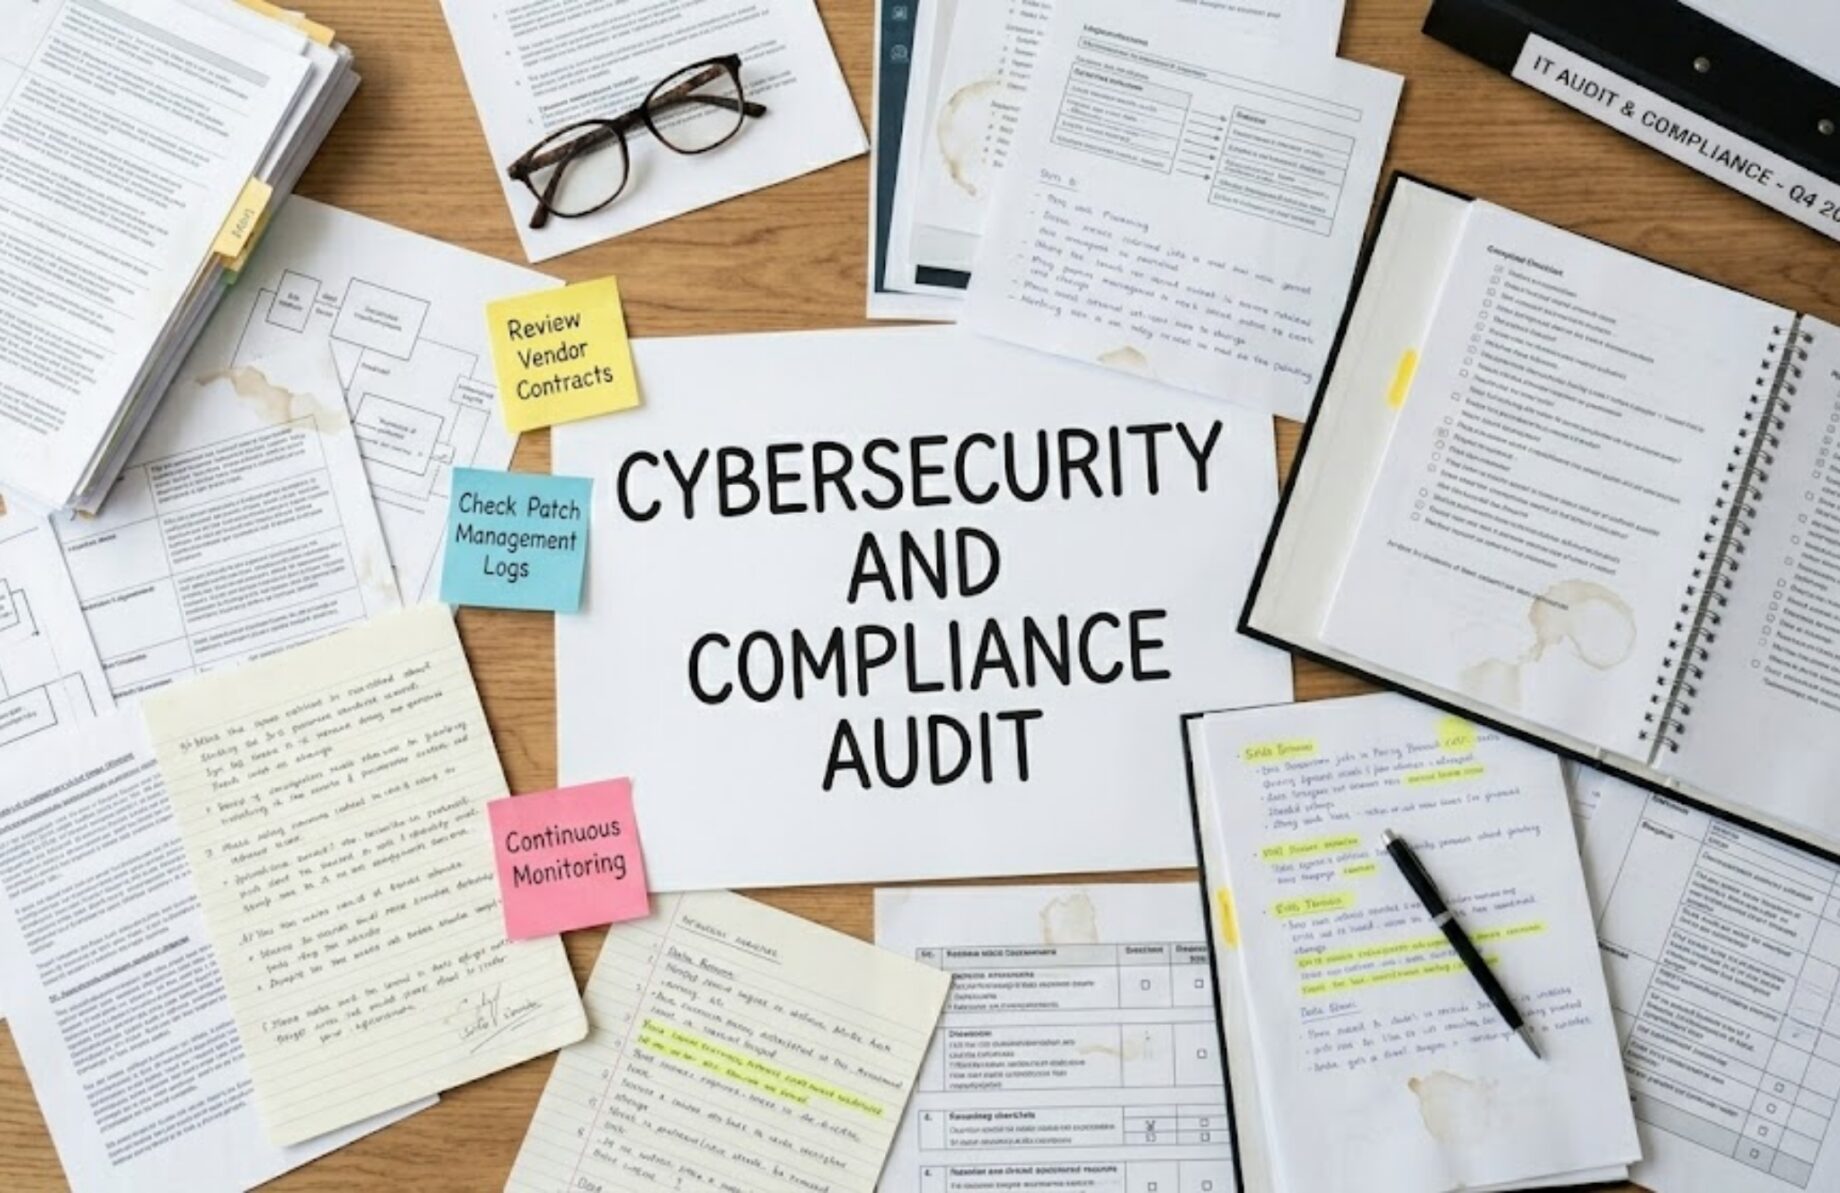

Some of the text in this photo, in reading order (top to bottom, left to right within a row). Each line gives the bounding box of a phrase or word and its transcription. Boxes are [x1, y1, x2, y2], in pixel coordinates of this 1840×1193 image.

[1533, 55, 1556, 75] IT
[1556, 68, 1619, 107] AUDIT
[1620, 100, 1635, 118] &
[1641, 110, 1774, 186] COMPLIANCE
[1789, 184, 1818, 208] Q4
[507, 313, 581, 341] Review
[517, 341, 588, 369] Vendor
[516, 365, 614, 401] Contracts
[616, 420, 1223, 523] CYBERSECURITY
[459, 491, 581, 520] Check Patch
[456, 522, 577, 554] Management
[483, 554, 530, 584] Logs
[846, 526, 1001, 605] AND
[688, 609, 1172, 705] COMPLIANCE
[822, 708, 1044, 792] AUDIT
[505, 820, 621, 854] Continuous
[513, 853, 626, 888] Monitoring
